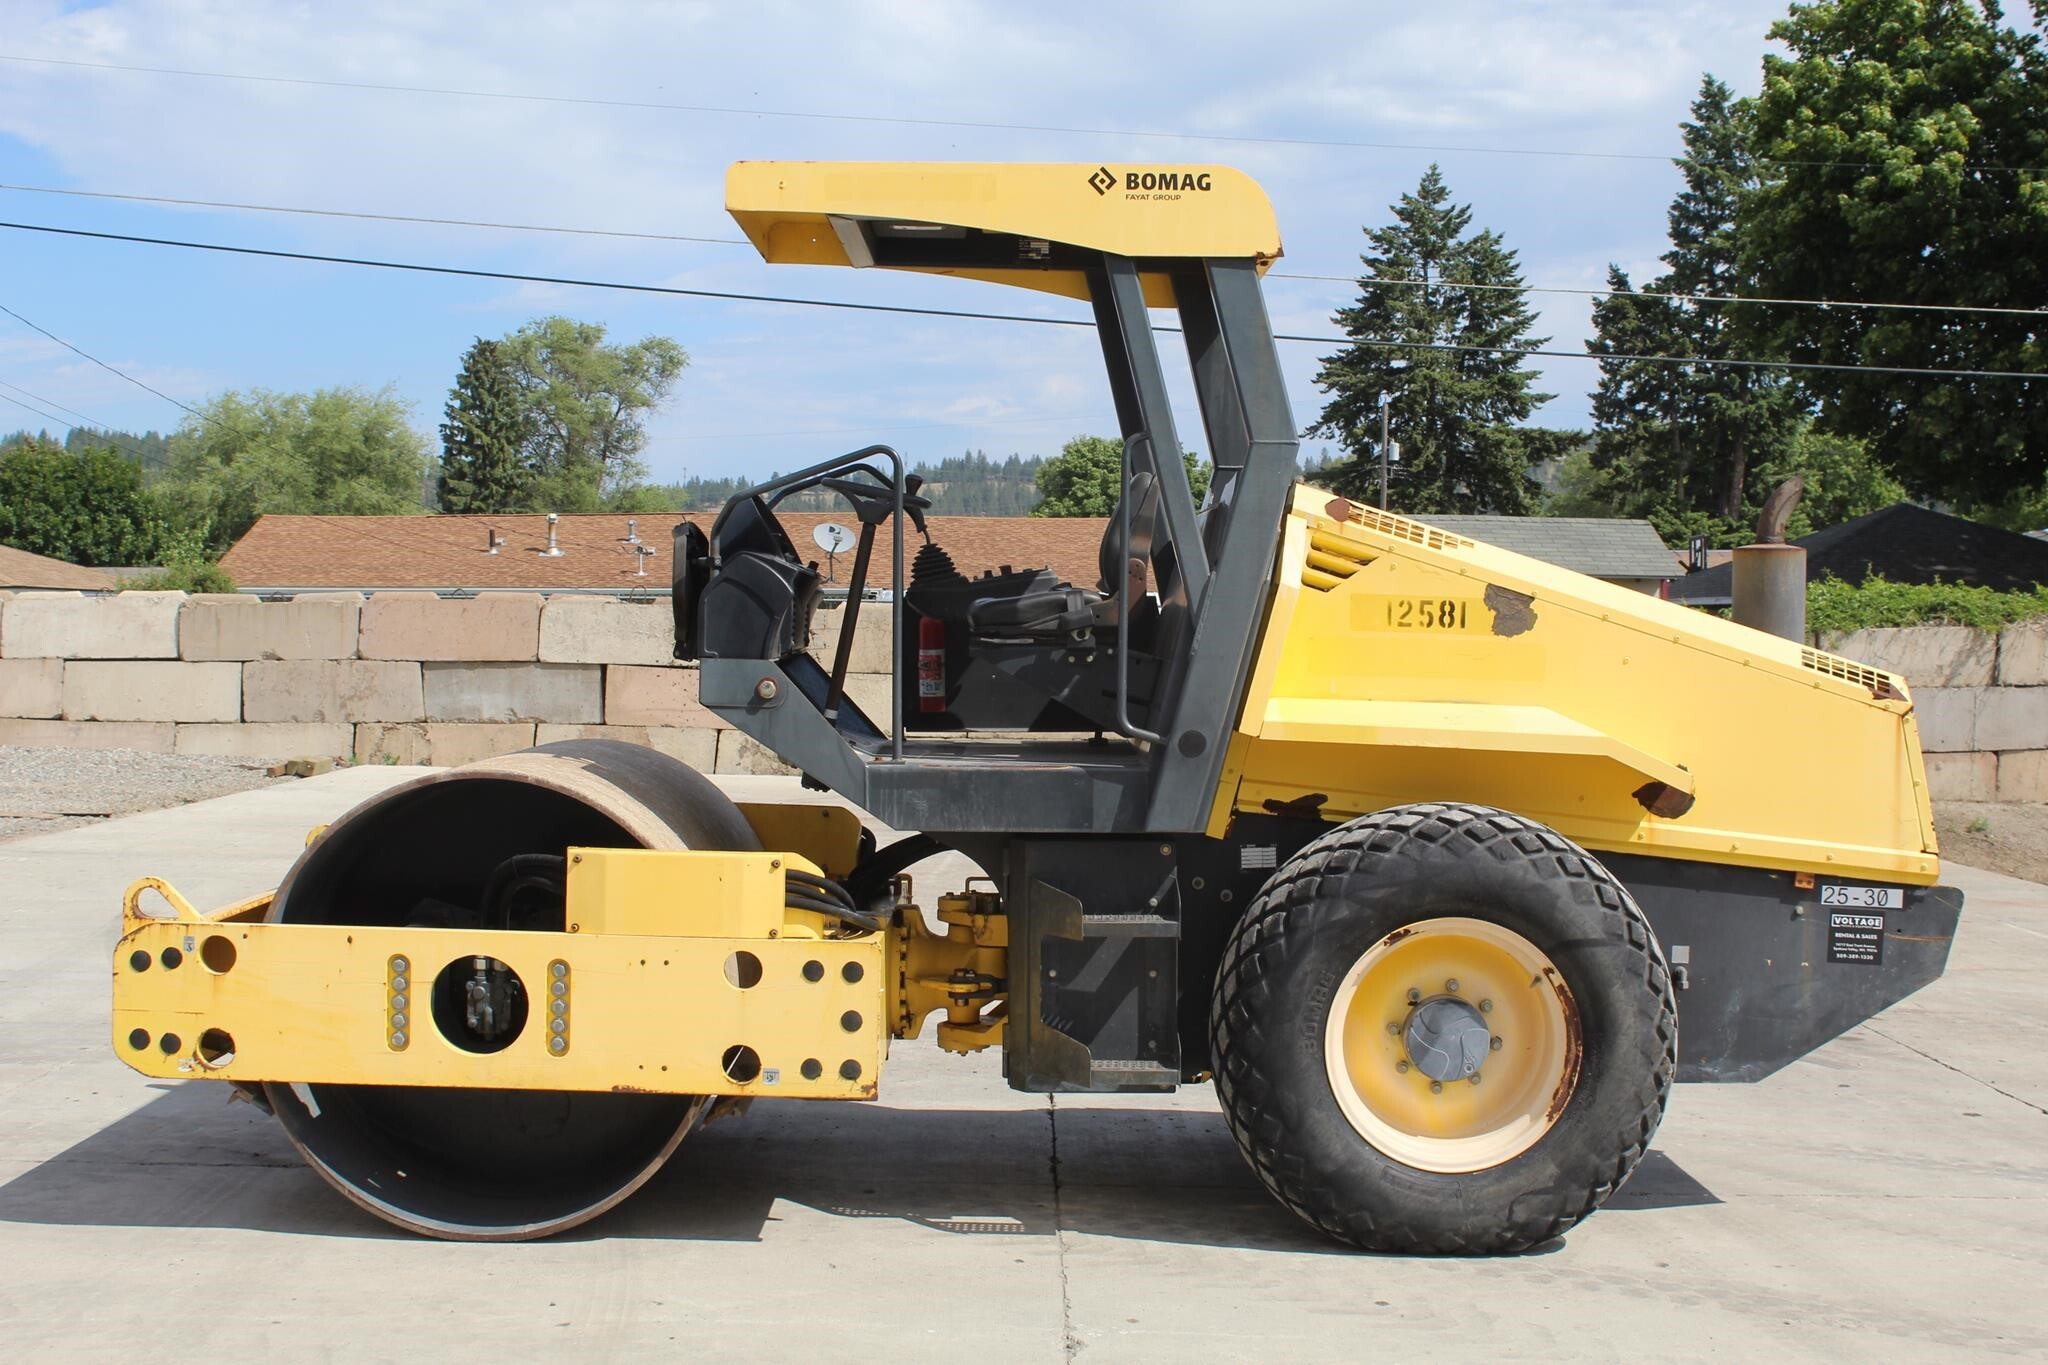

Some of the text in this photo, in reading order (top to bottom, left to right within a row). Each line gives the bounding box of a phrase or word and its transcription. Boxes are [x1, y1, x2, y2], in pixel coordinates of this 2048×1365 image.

[1126, 173, 1211, 191] BOMAG
[1387, 599, 1466, 629] 12581
[1823, 886, 1889, 907] 25-30
[1834, 916, 1880, 926] VOLTAGE
